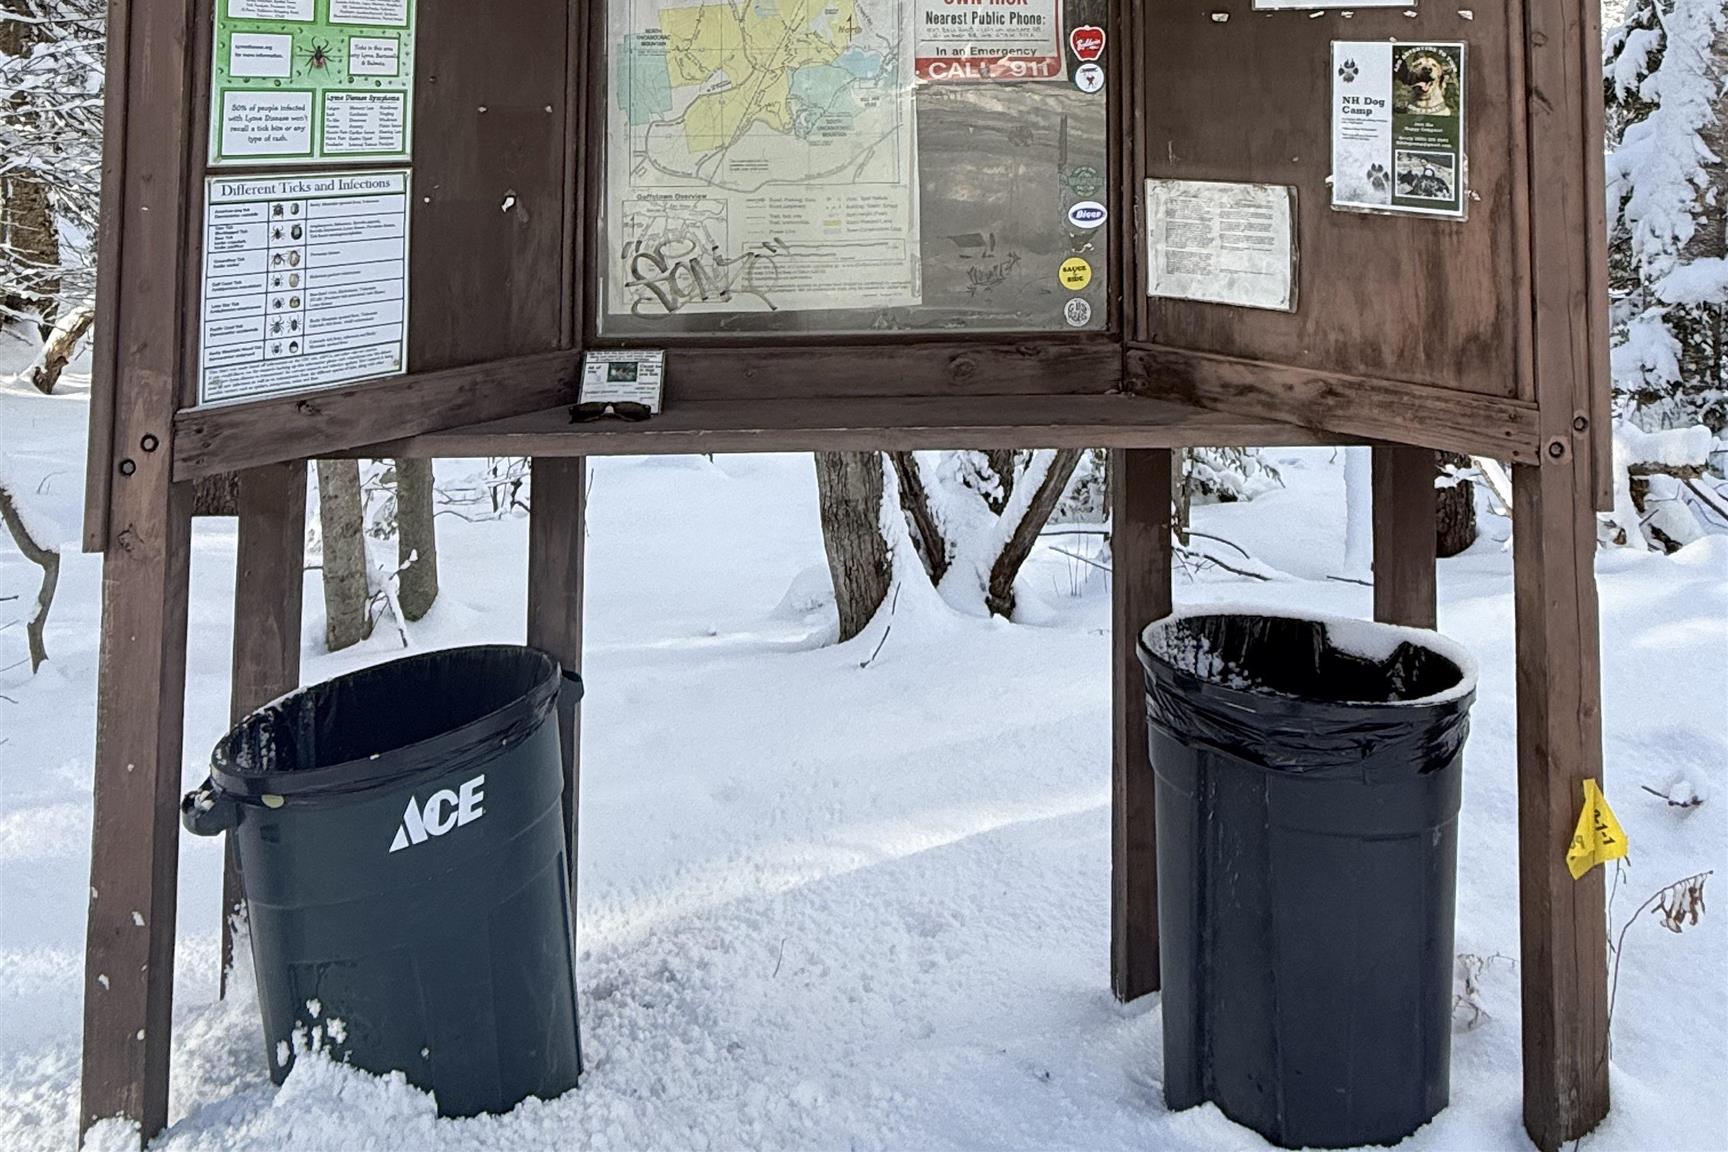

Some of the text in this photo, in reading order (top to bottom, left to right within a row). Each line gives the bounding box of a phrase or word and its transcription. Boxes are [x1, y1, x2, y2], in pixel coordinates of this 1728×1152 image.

[925, 11, 1046, 25] Nearest Public Phone:
[936, 47, 1037, 57] In an Emergency
[1011, 61, 1049, 77] 911
[369, 94, 400, 103] Symptoms
[1342, 96, 1385, 108] NH Dog
[257, 104, 279, 113] people
[1342, 106, 1373, 116] Camp
[245, 114, 262, 123] Lyme
[230, 124, 249, 132] recall
[247, 135, 262, 143] type
[264, 134, 271, 142] of
[221, 179, 391, 197] Different Ticks and Infections
[389, 774, 485, 853] ACE
